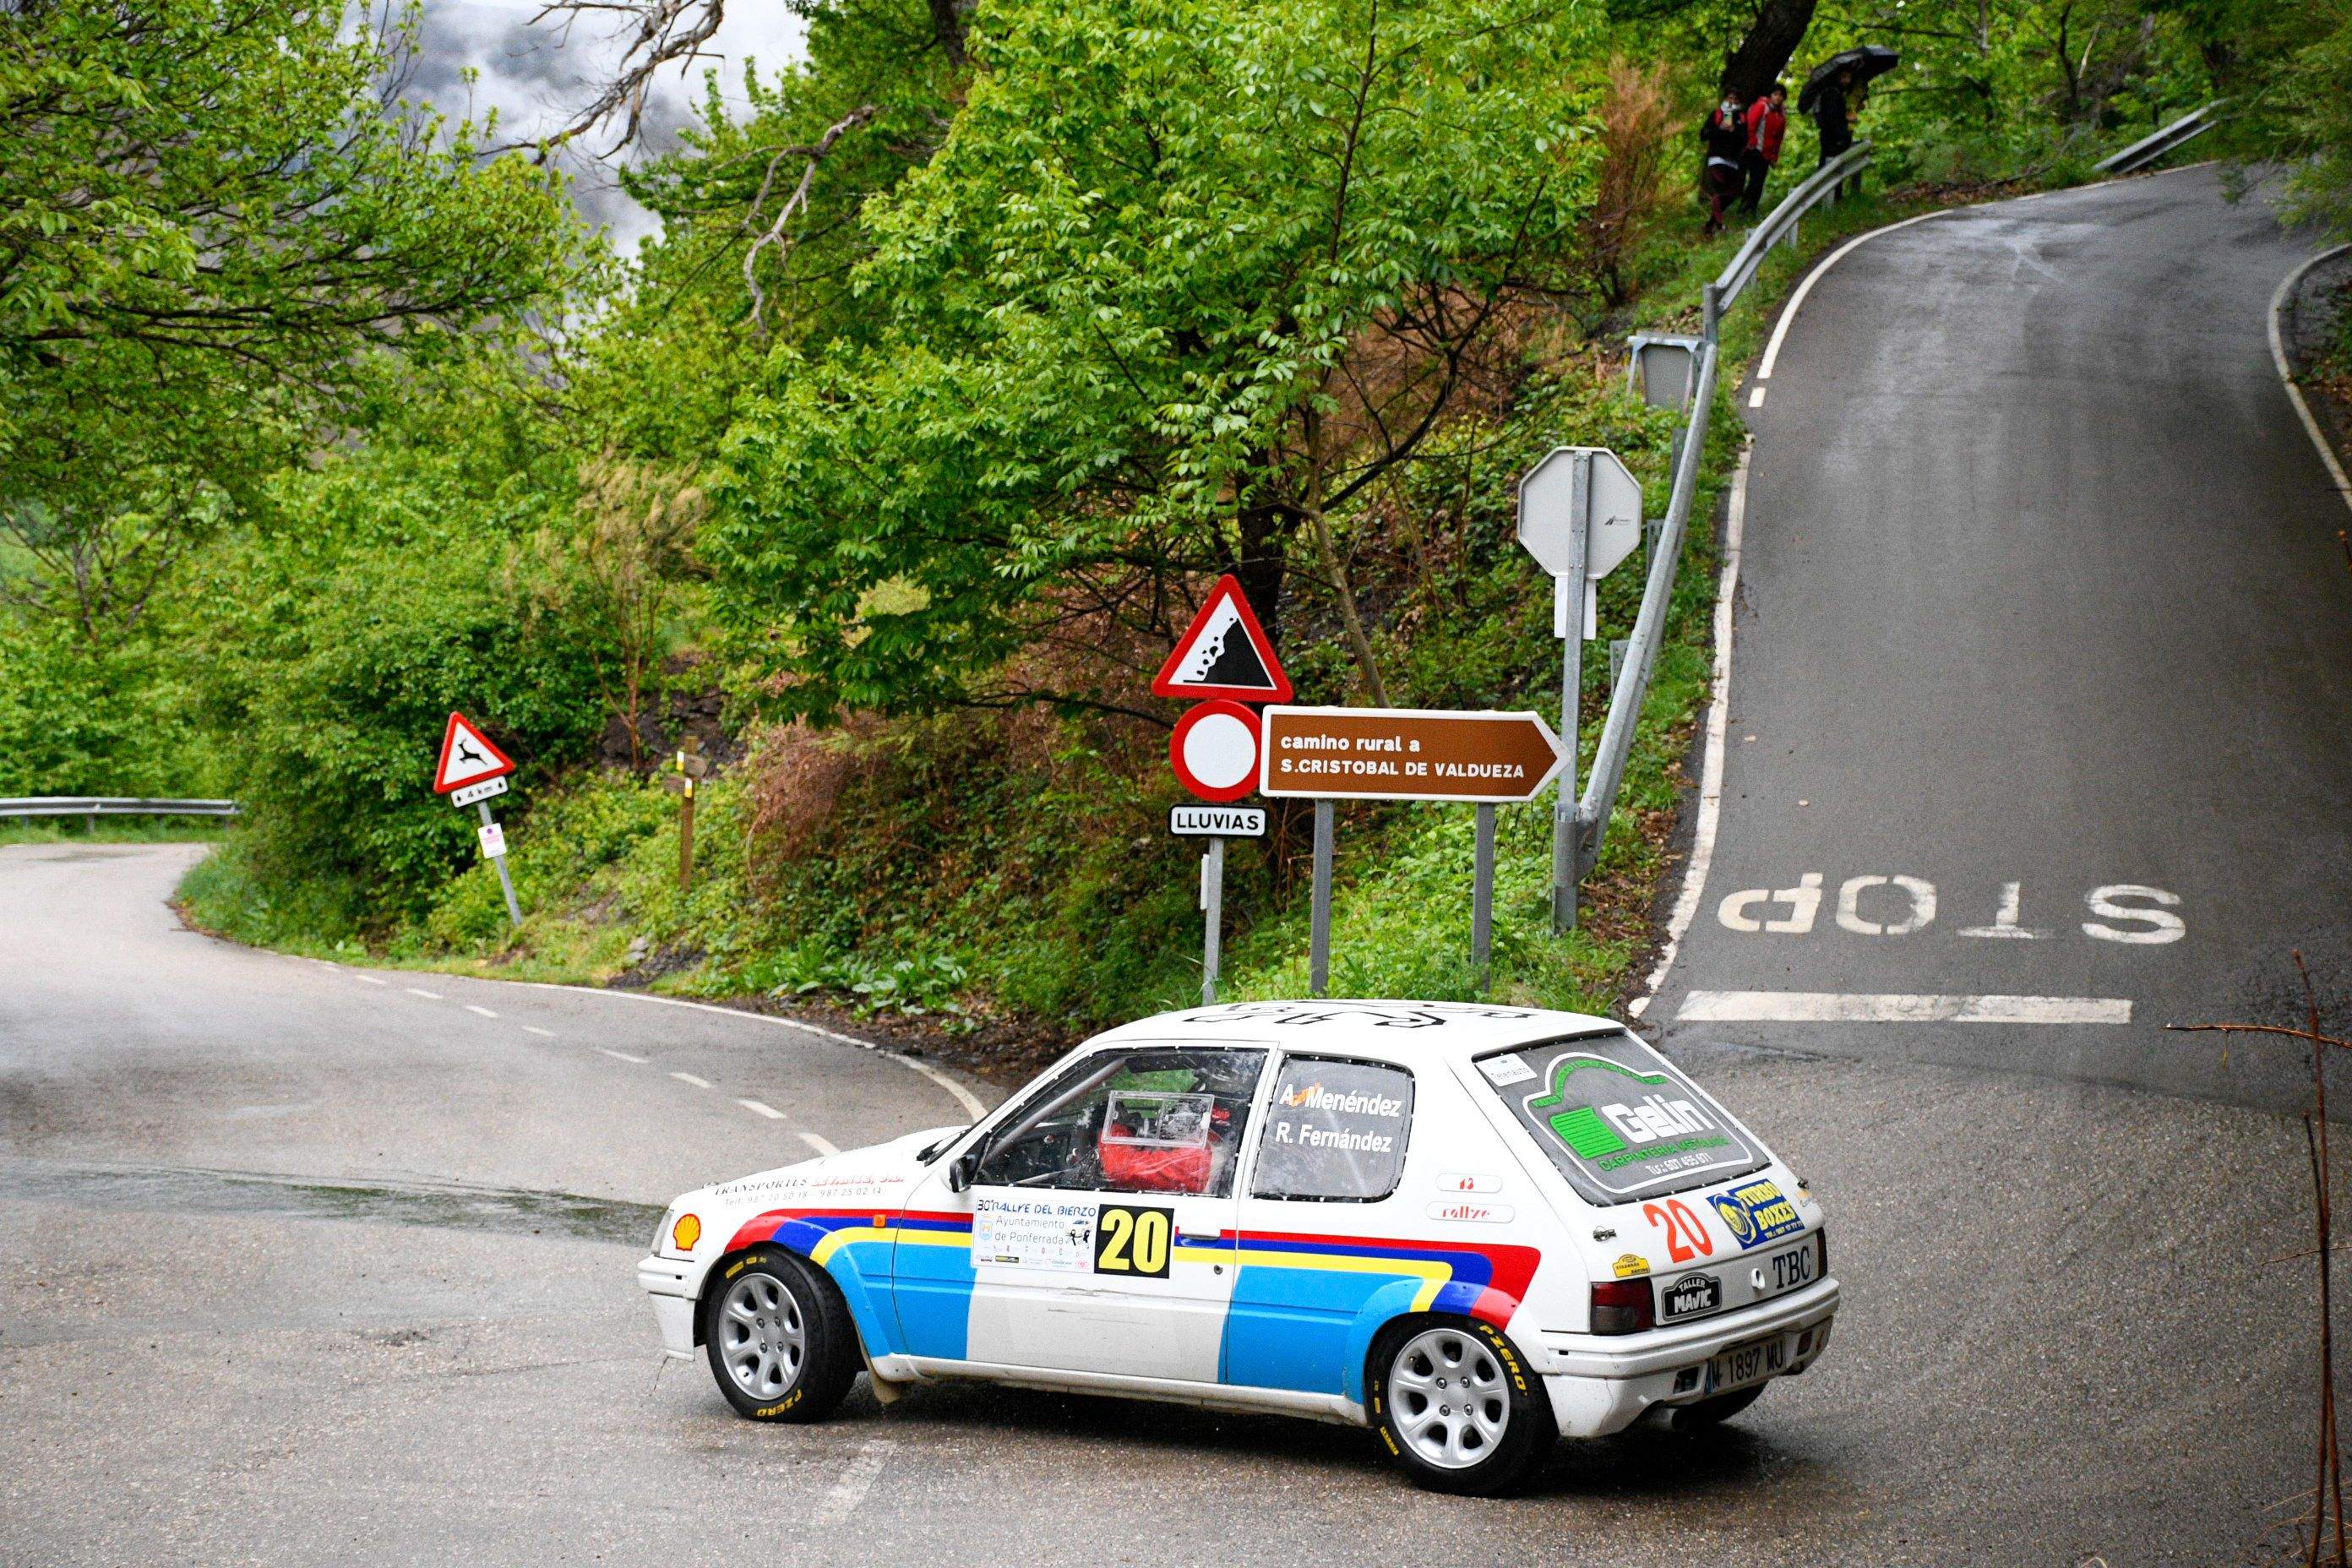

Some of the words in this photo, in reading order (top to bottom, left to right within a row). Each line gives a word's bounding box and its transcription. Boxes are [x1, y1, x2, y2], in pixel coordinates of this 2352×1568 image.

[1280, 733, 1349, 750] camino
[1356, 735, 1402, 752] rural
[1408, 739, 1420, 753] a
[1280, 759, 1399, 776] S.CRISTOBAL
[1405, 761, 1428, 776] DE
[1435, 762, 1524, 778] VALDUEZA
[1177, 813, 1259, 830] LLUVIAS
[1717, 873, 2186, 944] STOP
[1304, 1085, 1402, 1118] Menéndez
[1601, 1093, 1716, 1144] Gelin
[1275, 1121, 1293, 1144] R.
[1298, 1124, 1392, 1153] Fernández
[992, 1200, 1031, 1213] RALLYE
[1034, 1204, 1053, 1214] DEL
[1057, 1206, 1097, 1217] BIERZO
[1734, 1181, 1782, 1206] TURBO
[995, 1216, 1064, 1229] Ayuntamiento
[1754, 1200, 1796, 1231] BOXES
[994, 1232, 1007, 1241] de
[1010, 1231, 1064, 1244] Ponferrada
[1098, 1208, 1168, 1273] 20
[1642, 1199, 1713, 1264] 20
[1772, 1244, 1810, 1289] TBC
[1679, 1277, 1705, 1292] TALLER
[1728, 1346, 1761, 1384] 1897
